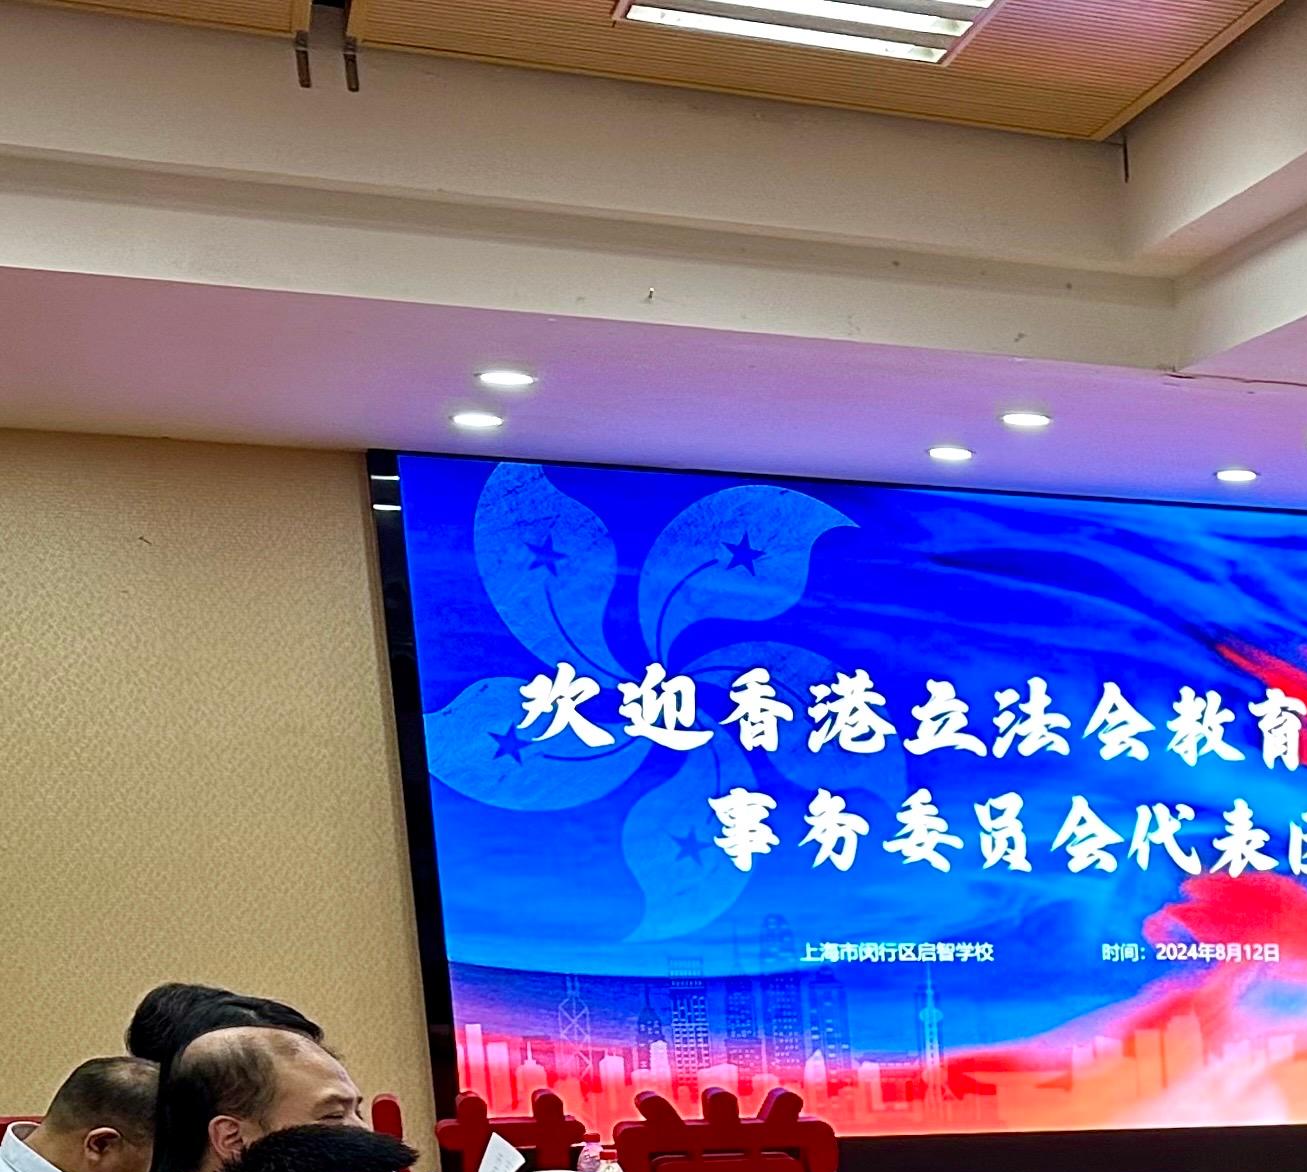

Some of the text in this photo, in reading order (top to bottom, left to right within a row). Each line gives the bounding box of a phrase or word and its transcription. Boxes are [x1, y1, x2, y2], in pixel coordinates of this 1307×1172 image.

[517, 660, 1307, 771] 欢迎香港立法会教育
[800, 943, 995, 962] 上海市闵行区启智学校
